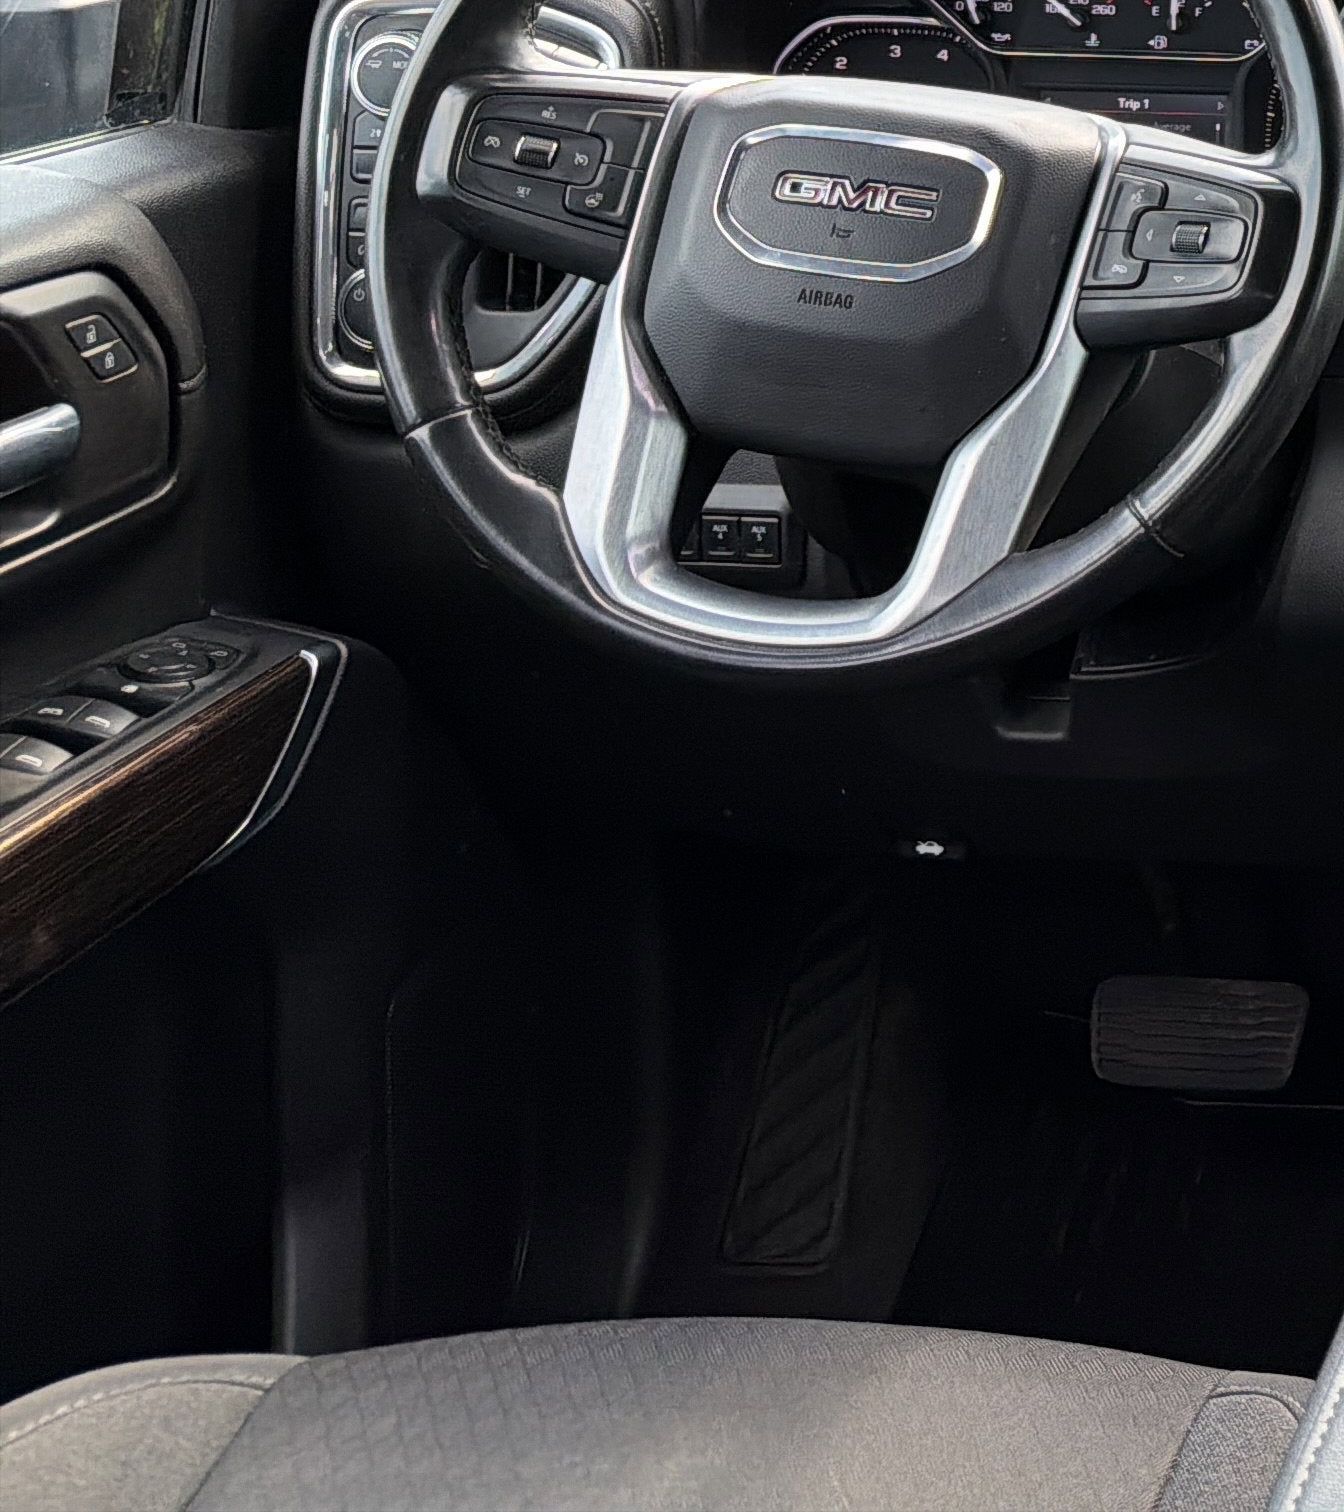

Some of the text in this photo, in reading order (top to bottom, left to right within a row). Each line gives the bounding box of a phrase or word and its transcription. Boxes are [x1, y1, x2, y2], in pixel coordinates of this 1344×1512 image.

[955, 2, 964, 11] 0
[993, 3, 1013, 12] 120
[1092, 5, 1116, 15] 260
[1152, 7, 1203, 17] E F
[835, 45, 949, 69] 2 3 4
[1118, 98, 1139, 110] Trip
[542, 110, 556, 120] RES
[517, 187, 530, 196] SET
[774, 171, 941, 222] GMC
[796, 290, 854, 311] AIRBAG
[751, 526, 767, 534] AUX
